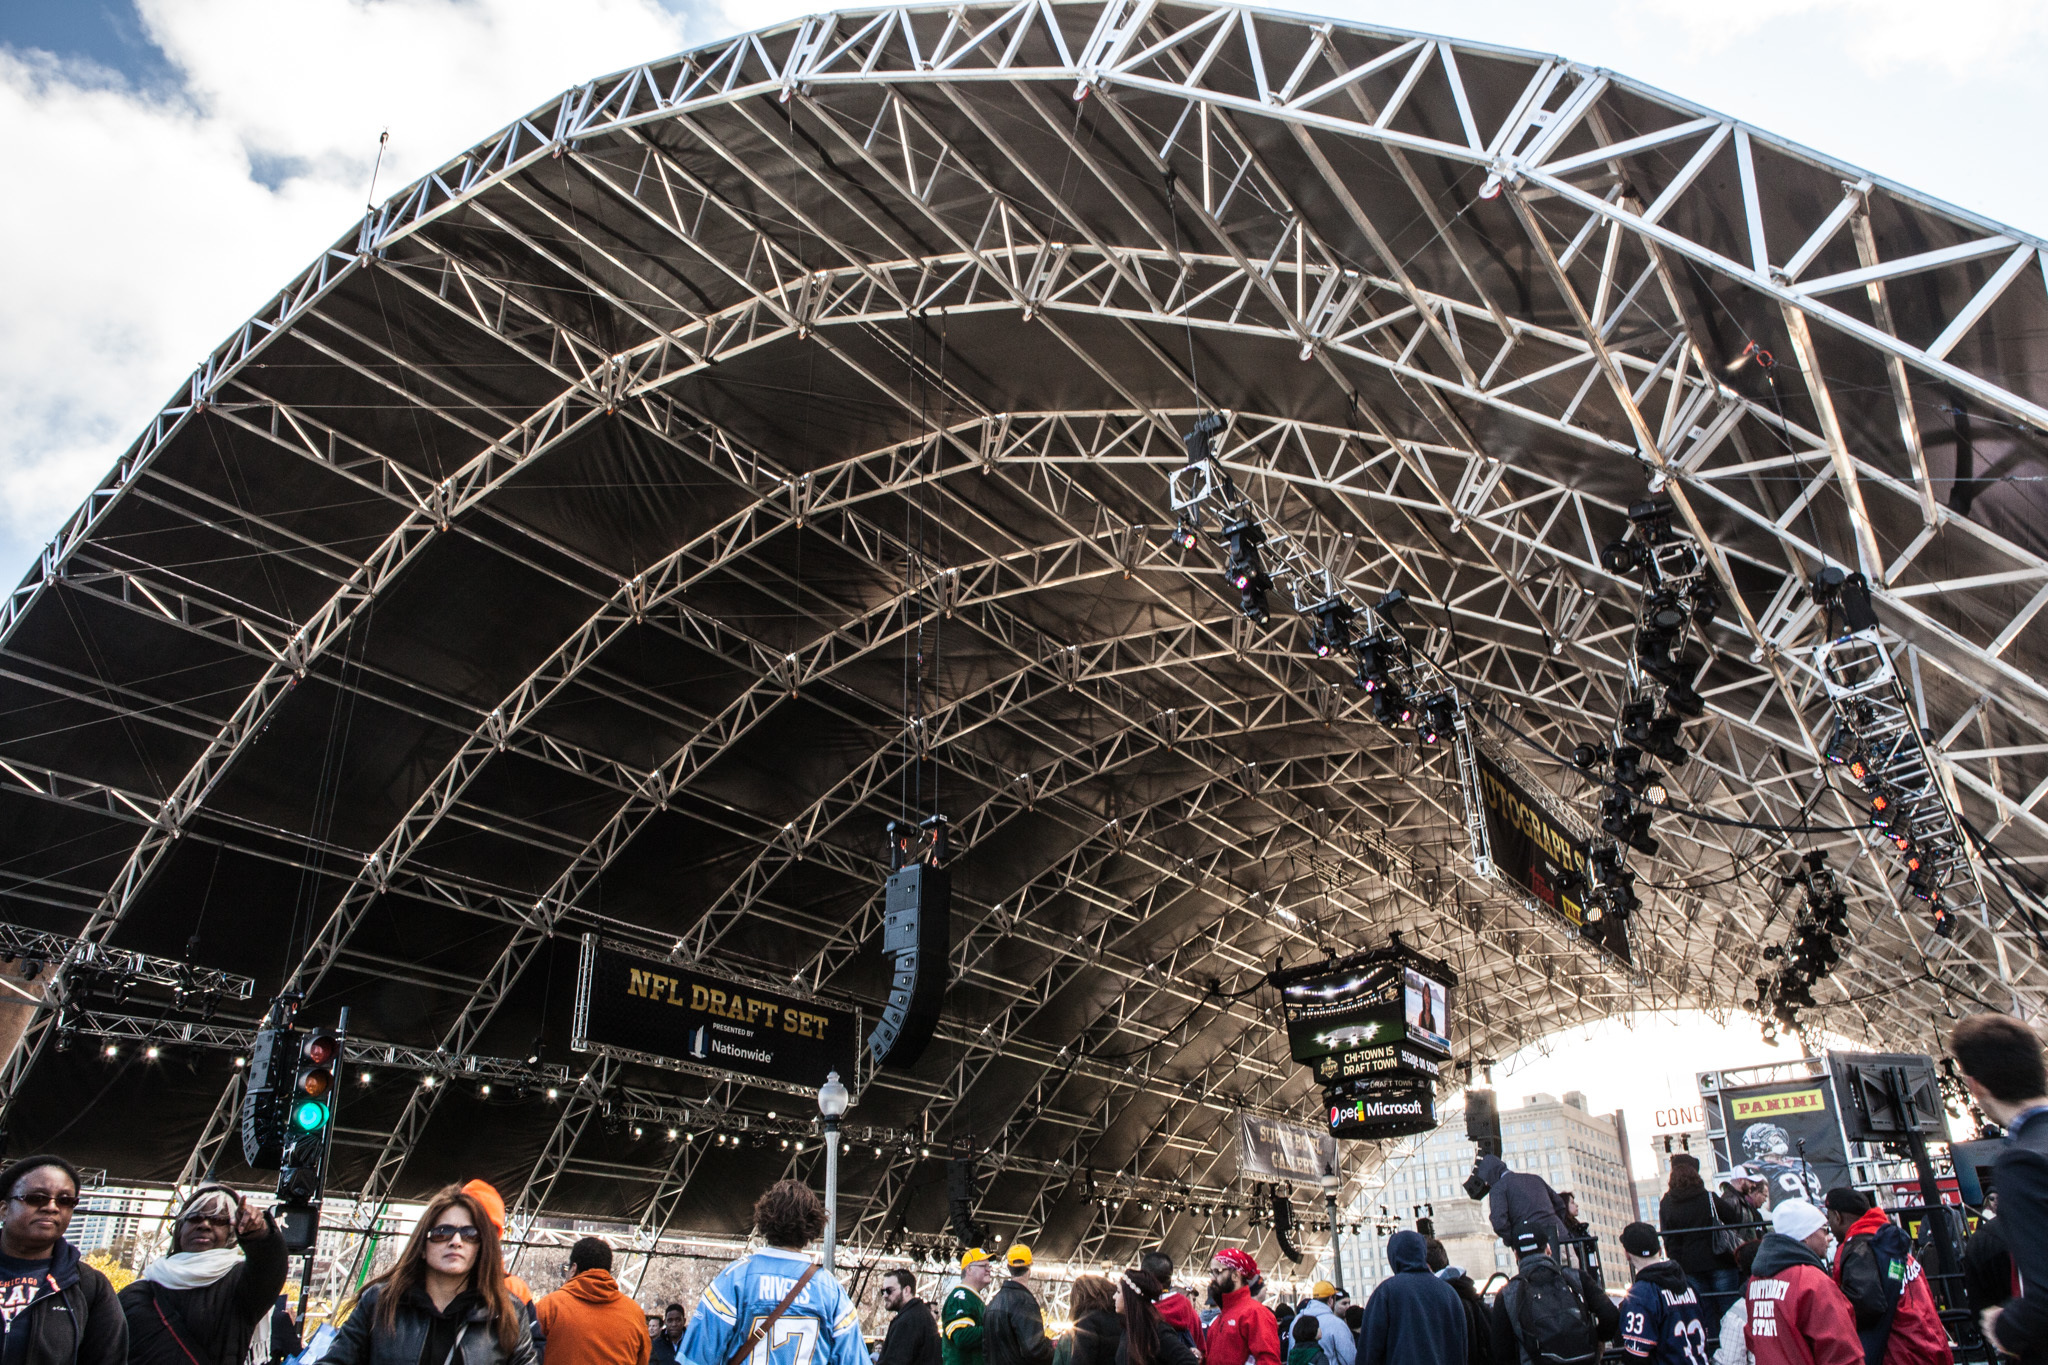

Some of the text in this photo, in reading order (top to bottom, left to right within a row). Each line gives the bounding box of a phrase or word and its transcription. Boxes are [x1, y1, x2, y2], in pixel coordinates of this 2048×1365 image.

[1482, 768, 1574, 871] UTOGRAPH
[628, 968, 829, 1040] NFL DRAFT SET
[713, 1022, 755, 1038] PRESENTED BY
[1344, 1045, 1395, 1064] CHI-TOWN IS
[1343, 1062, 1371, 1076] DRAFT
[1372, 1057, 1398, 1071] TOWN
[1366, 1100, 1423, 1117] Microsoft
[1738, 1094, 1818, 1115] PANINI
[1626, 1311, 1644, 1334] 33
